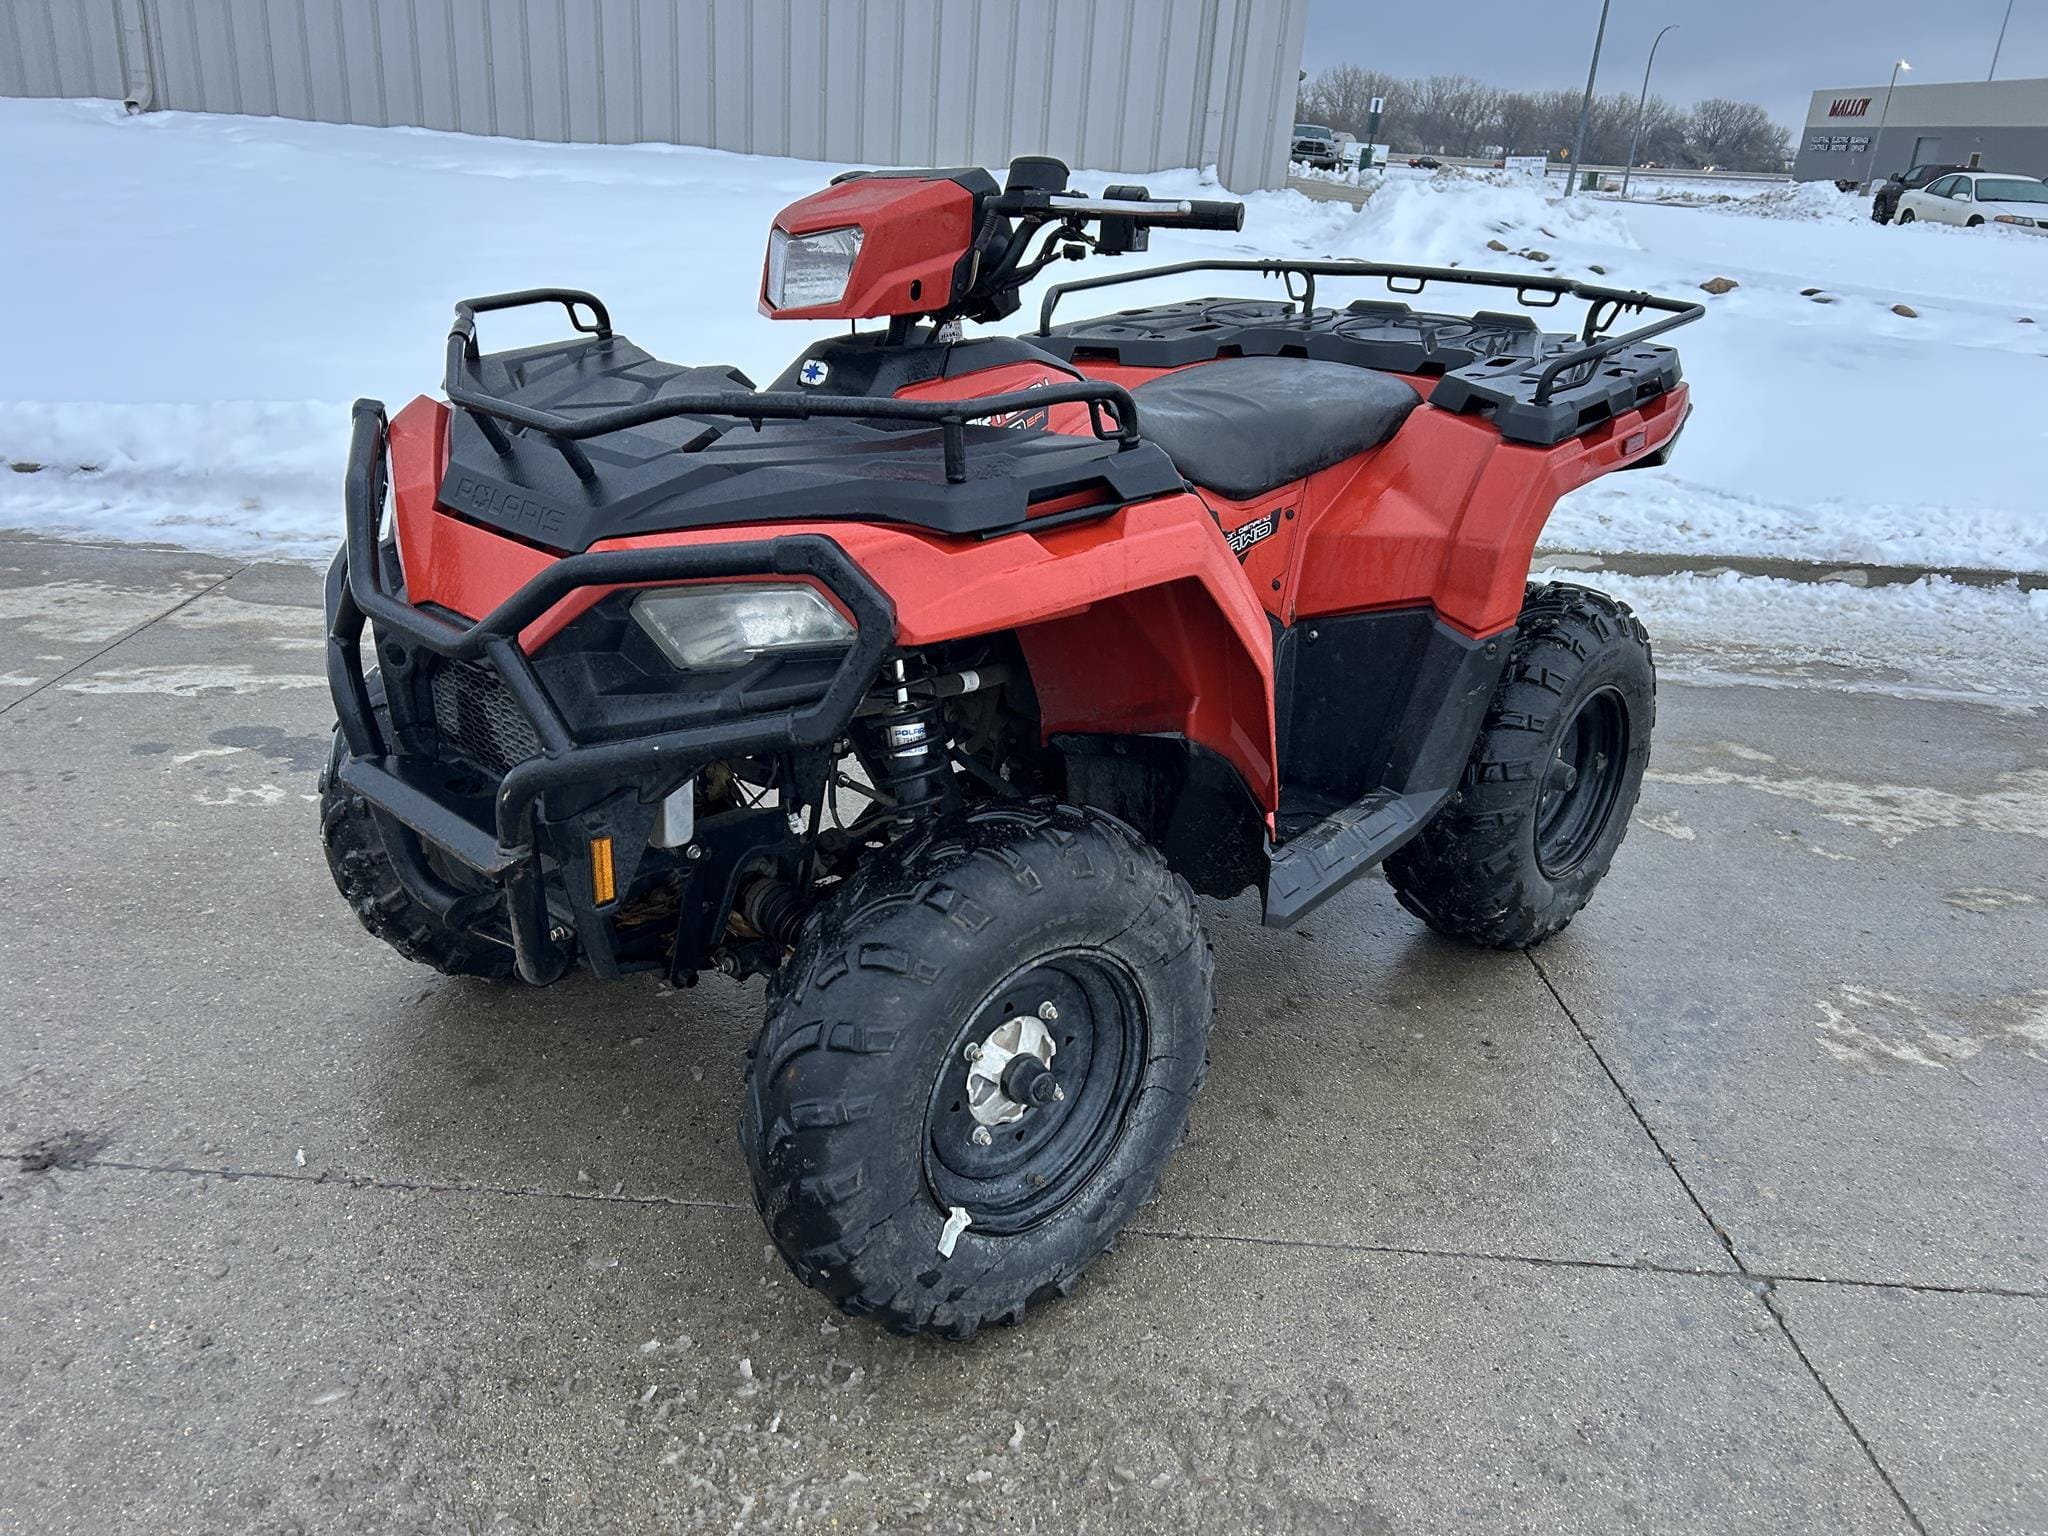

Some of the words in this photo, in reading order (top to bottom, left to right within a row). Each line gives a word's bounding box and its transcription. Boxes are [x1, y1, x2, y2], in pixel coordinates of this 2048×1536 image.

[1828, 98, 1872, 117] MALLOY
[455, 477, 566, 533] POLARIS
[1227, 521, 1272, 551] AWD
[1238, 514, 1272, 534] DEMAND
